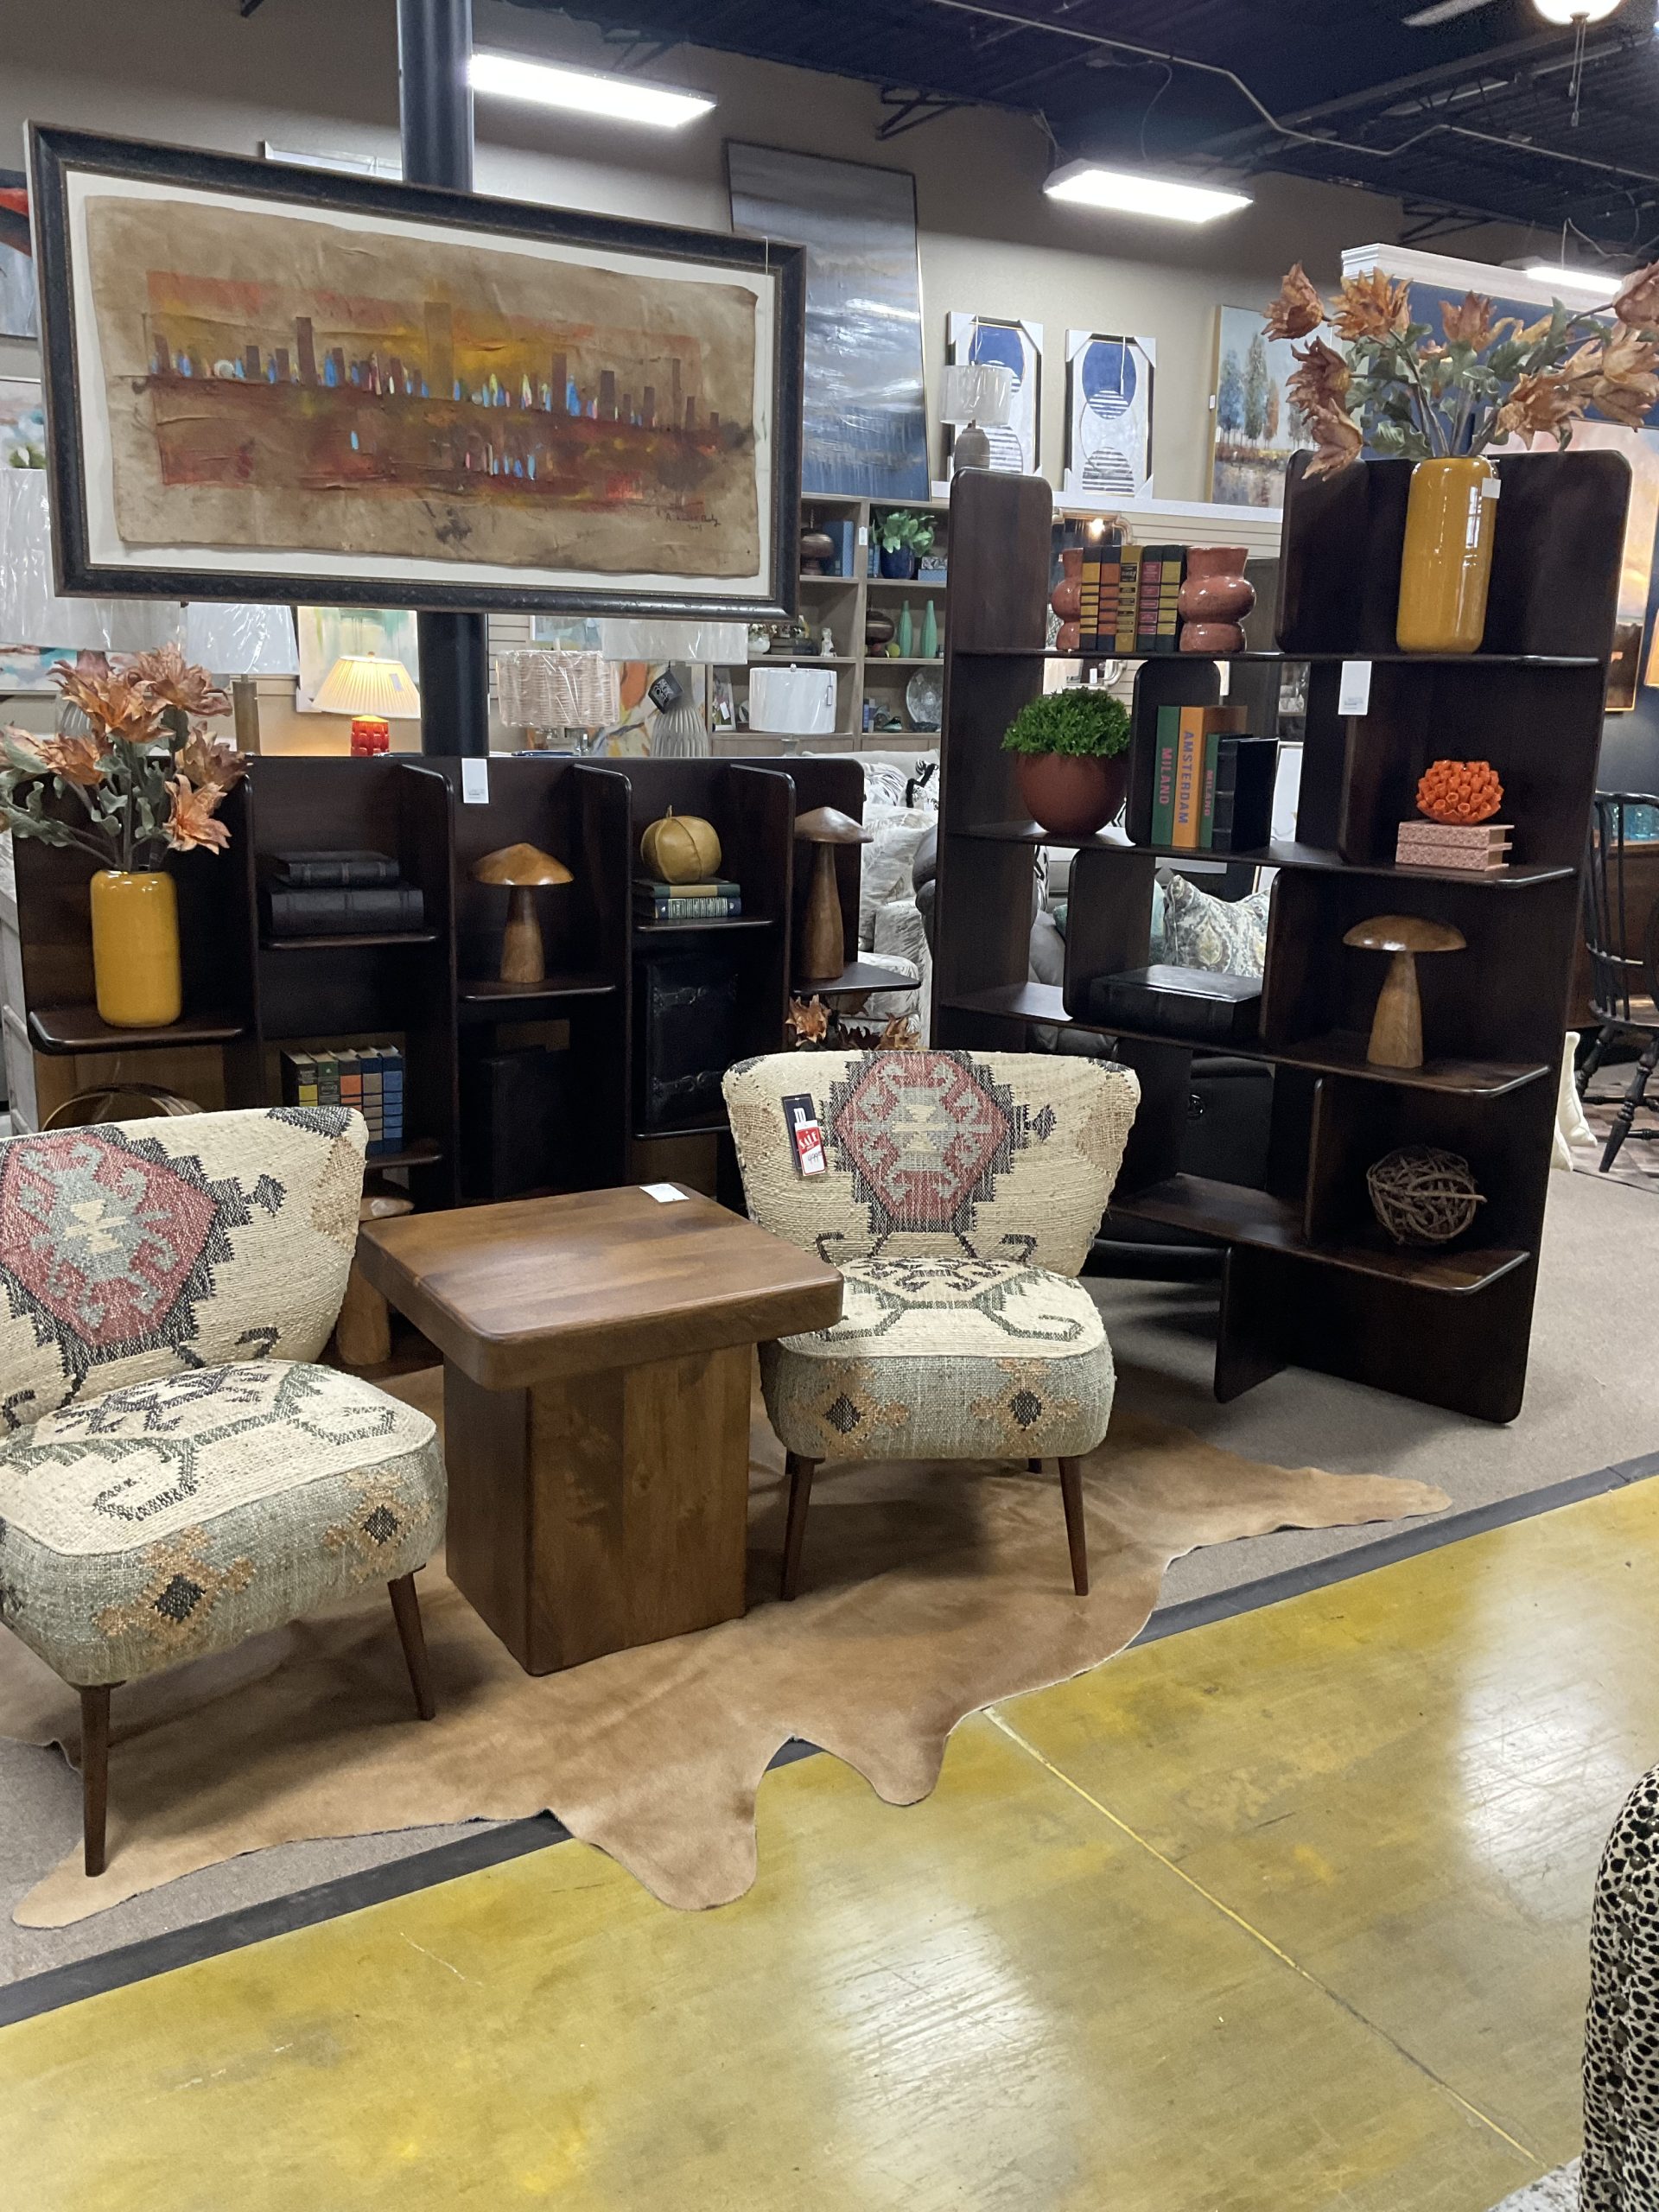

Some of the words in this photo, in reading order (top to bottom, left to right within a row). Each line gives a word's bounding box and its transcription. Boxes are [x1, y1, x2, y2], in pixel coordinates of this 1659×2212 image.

[1160, 748, 1173, 804] MILANO
[1179, 732, 1194, 823] AMSTERDAM
[1205, 770, 1214, 816] MILANO
[799, 1132, 817, 1149] SALE
